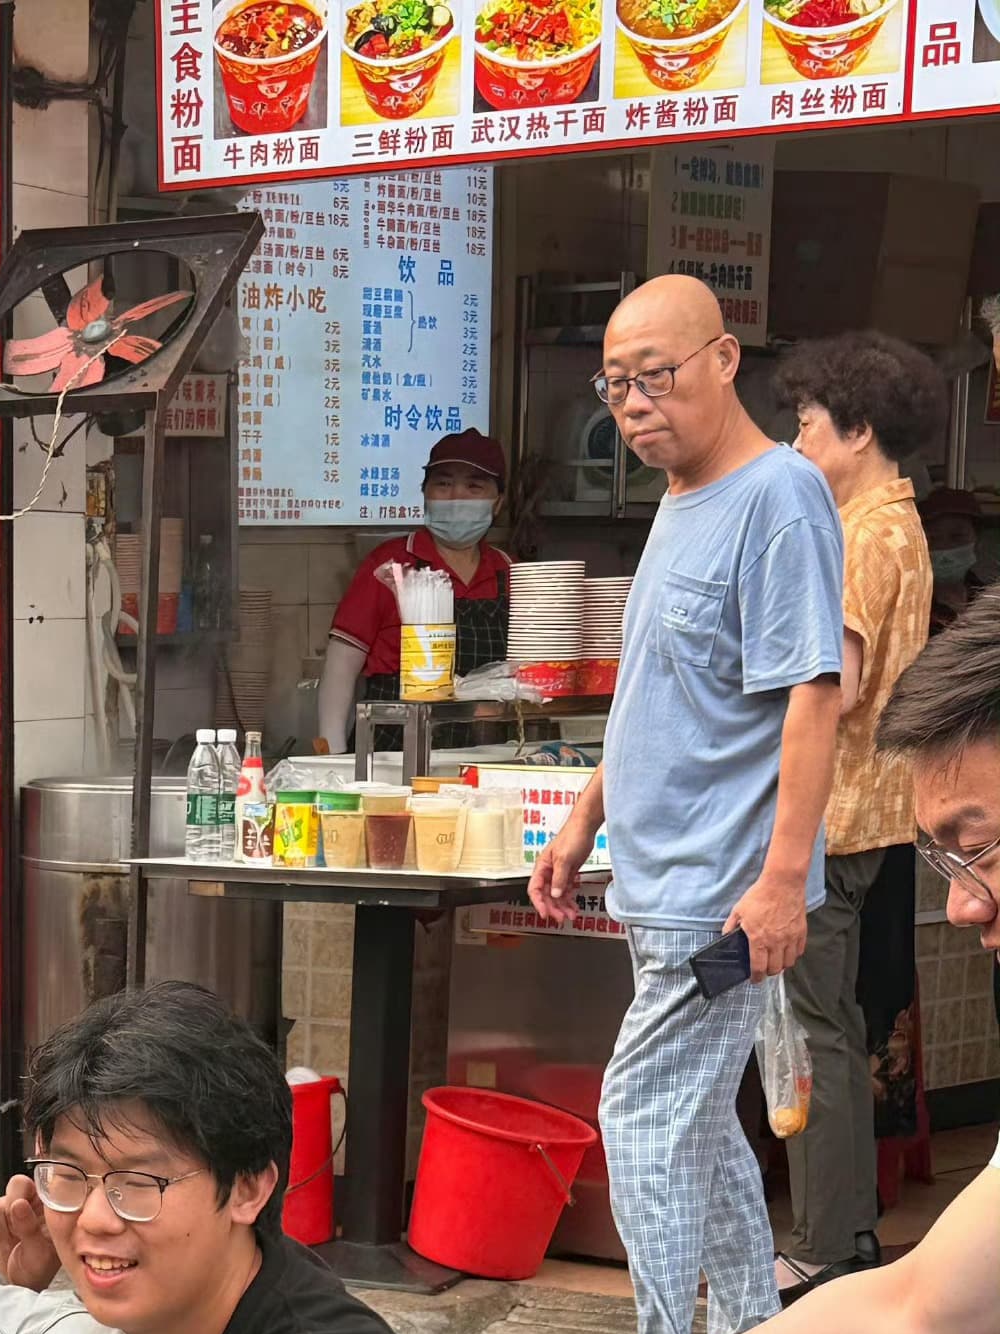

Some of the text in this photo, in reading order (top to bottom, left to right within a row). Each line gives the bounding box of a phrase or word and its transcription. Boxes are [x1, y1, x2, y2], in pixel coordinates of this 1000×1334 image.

[169, 0, 202, 176] 主食粉面
[771, 81, 889, 120] 肉丝粉面
[470, 108, 607, 145] 武汉热干面
[625, 95, 738, 131] 炸酱粉面
[223, 136, 320, 170] 牛肉粉面
[351, 123, 455, 159] 三鲜粉面
[398, 254, 455, 287] 饮品
[242, 281, 327, 314] 油炸小吃
[384, 404, 462, 432] 时令饮品
